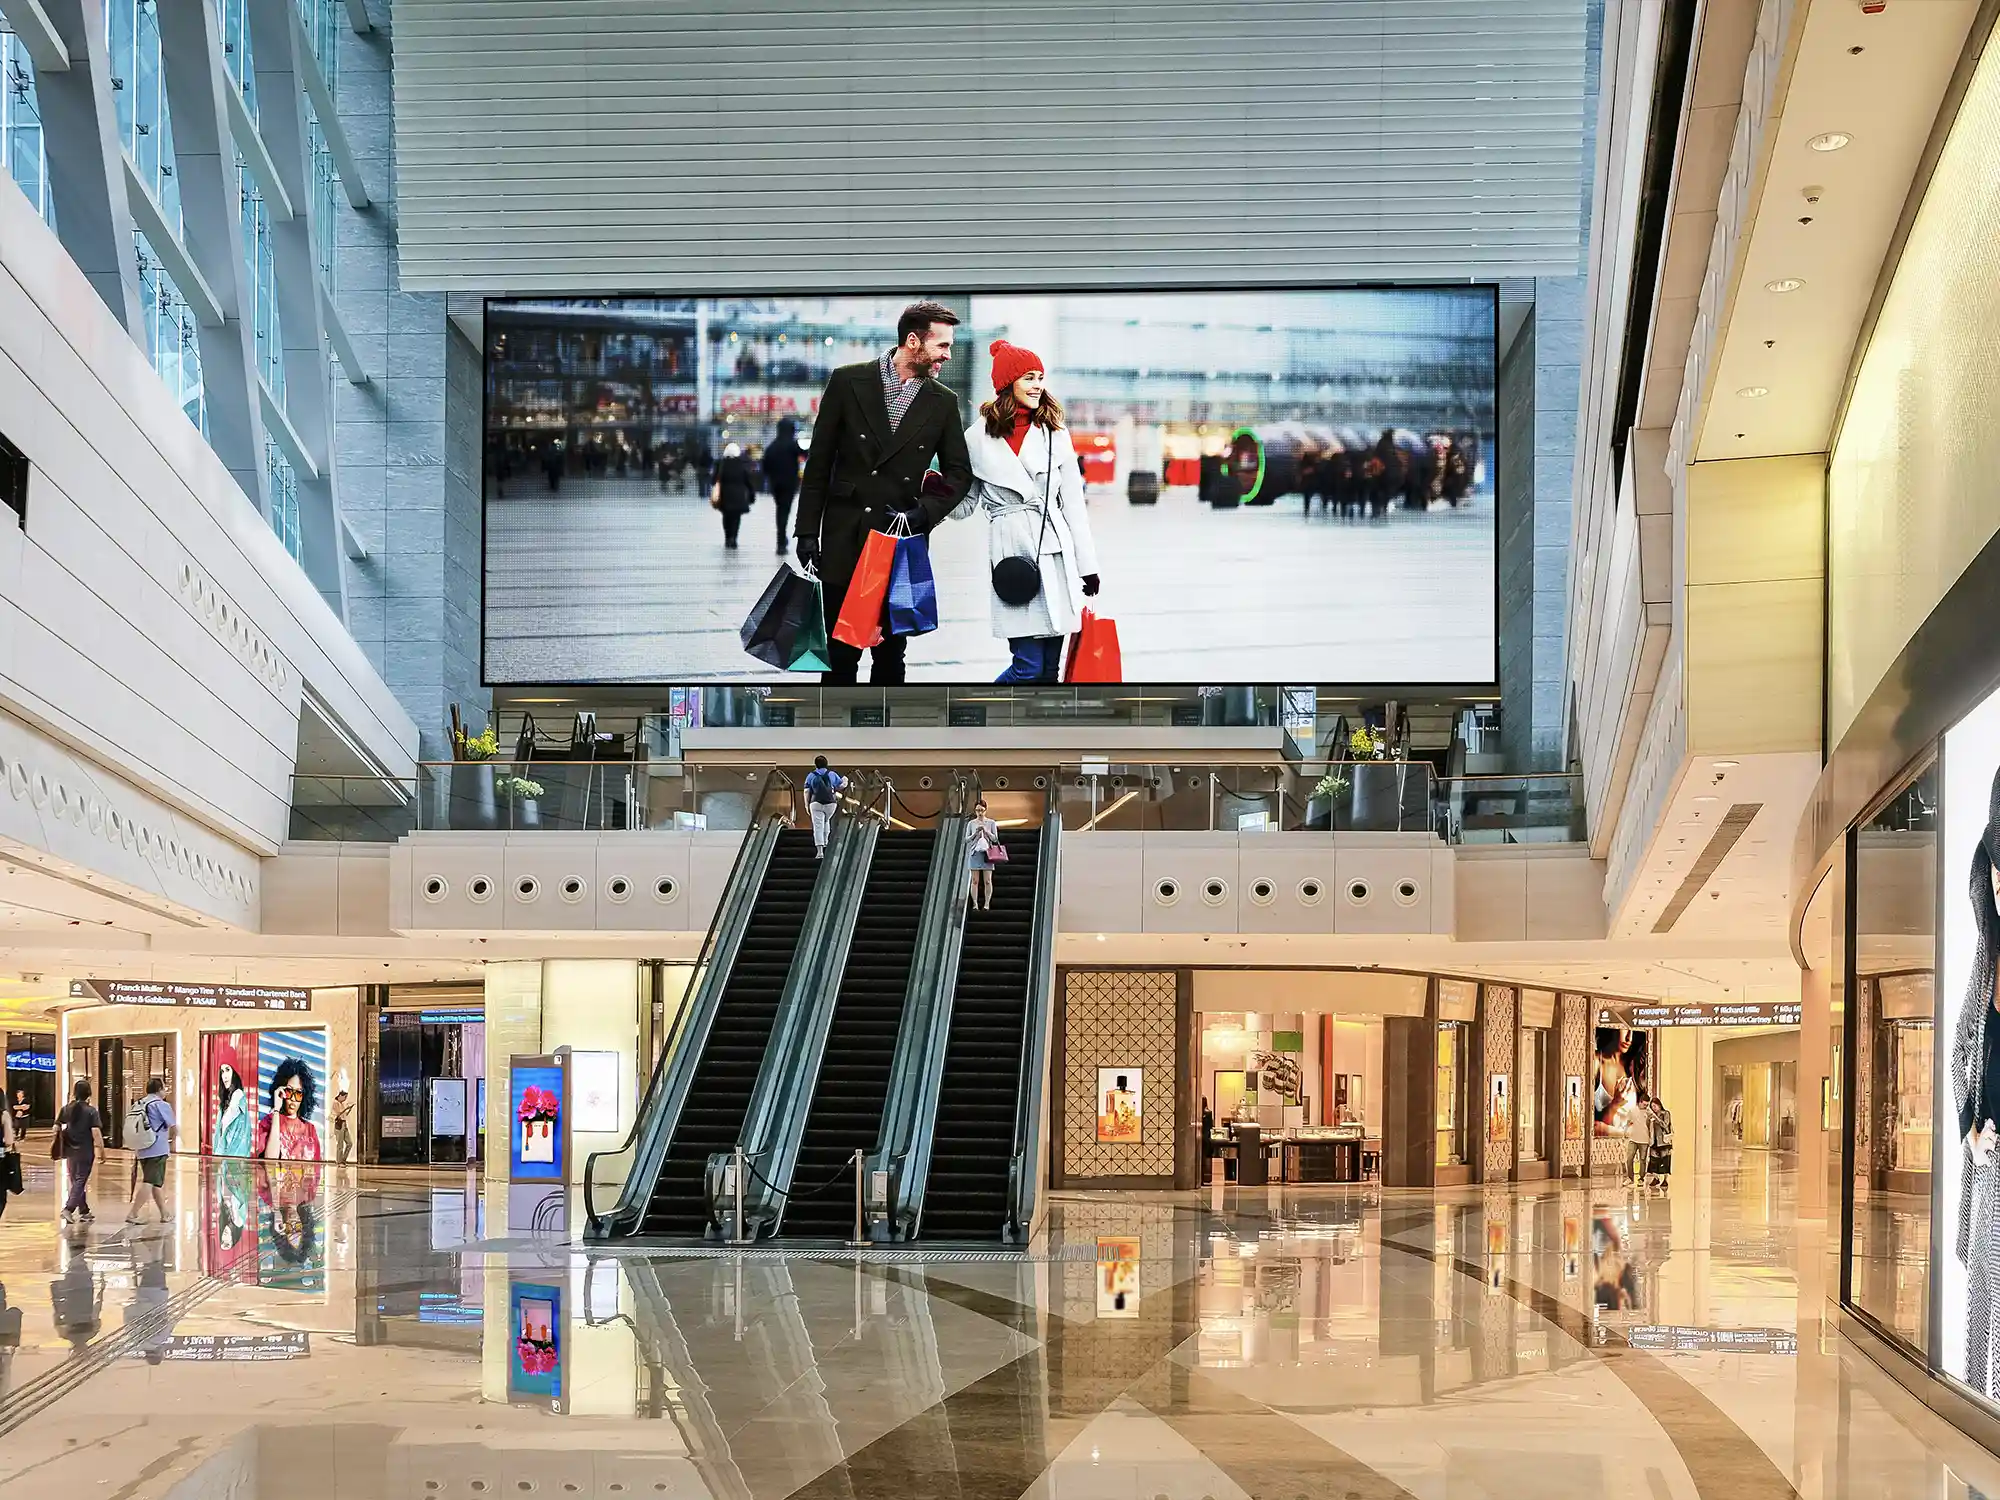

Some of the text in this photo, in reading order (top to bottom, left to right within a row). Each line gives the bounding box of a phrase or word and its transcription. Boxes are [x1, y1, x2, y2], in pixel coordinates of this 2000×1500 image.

[117, 982, 141, 992] Franck
[174, 985, 215, 995] Mango Tree
[225, 988, 307, 998] Standard Chartered Bank
[117, 995, 177, 1004] Dolce & Gabbana
[192, 997, 217, 1006] TASAKI
[232, 999, 256, 1008] Corum
[1680, 1007, 1702, 1015] Corum
[1720, 1006, 1761, 1014] Richard Mille
[1639, 1018, 1674, 1027] Mango Tree
[1720, 1016, 1772, 1025] Stella McCartney
